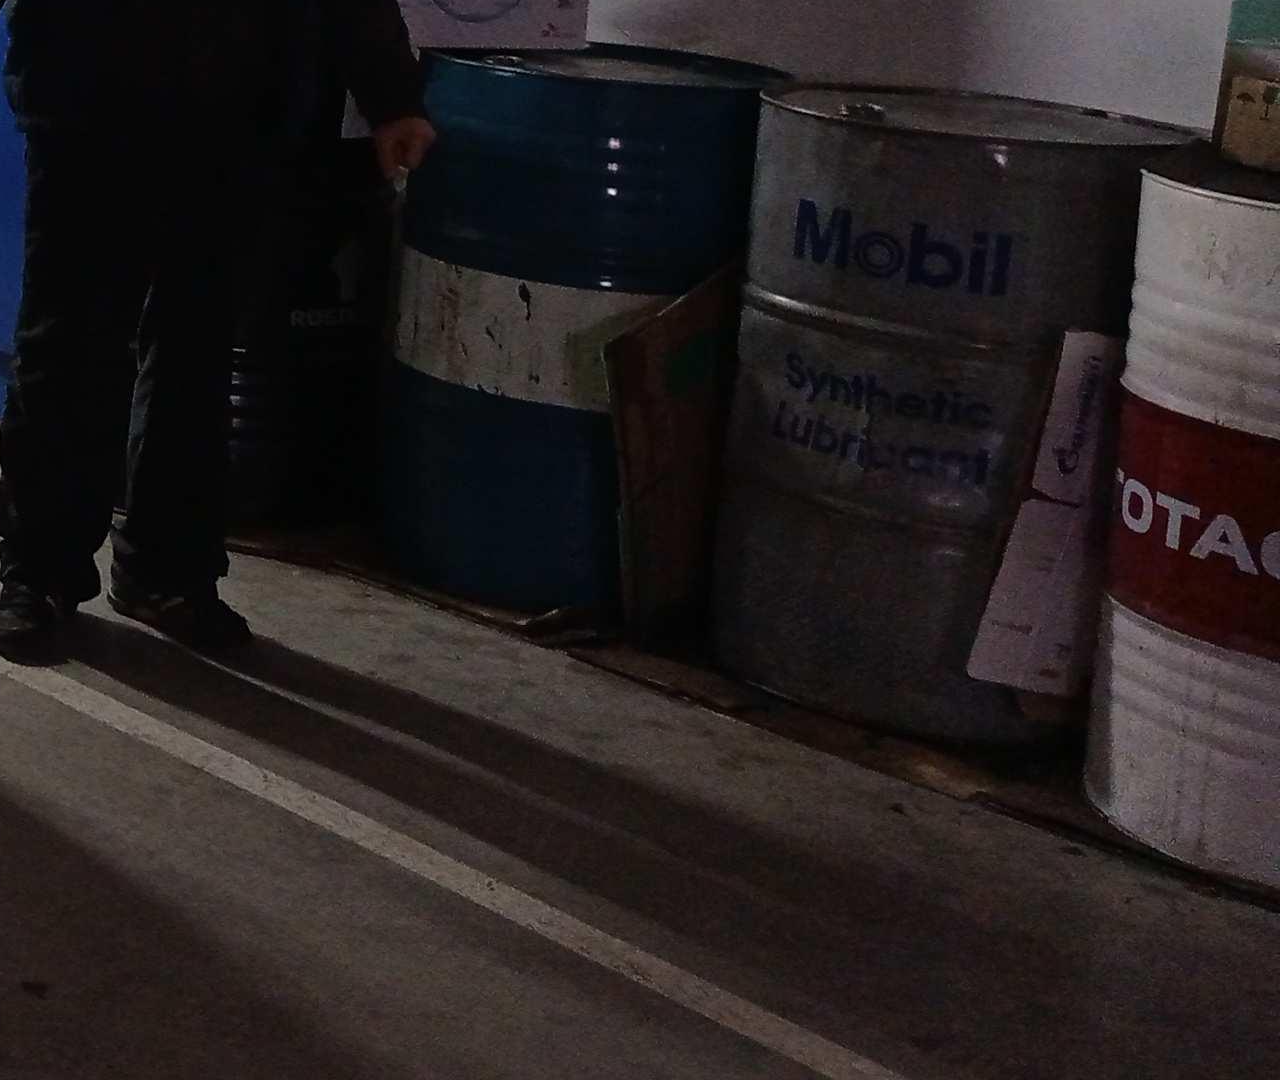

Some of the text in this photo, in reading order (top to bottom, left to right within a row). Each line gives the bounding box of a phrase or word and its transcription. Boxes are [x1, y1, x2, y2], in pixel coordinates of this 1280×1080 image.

[792, 198, 1013, 296] Mobil
[784, 351, 993, 427] Synthetic
[771, 399, 990, 484] Lubricant
[1115, 467, 1280, 581] OTA
